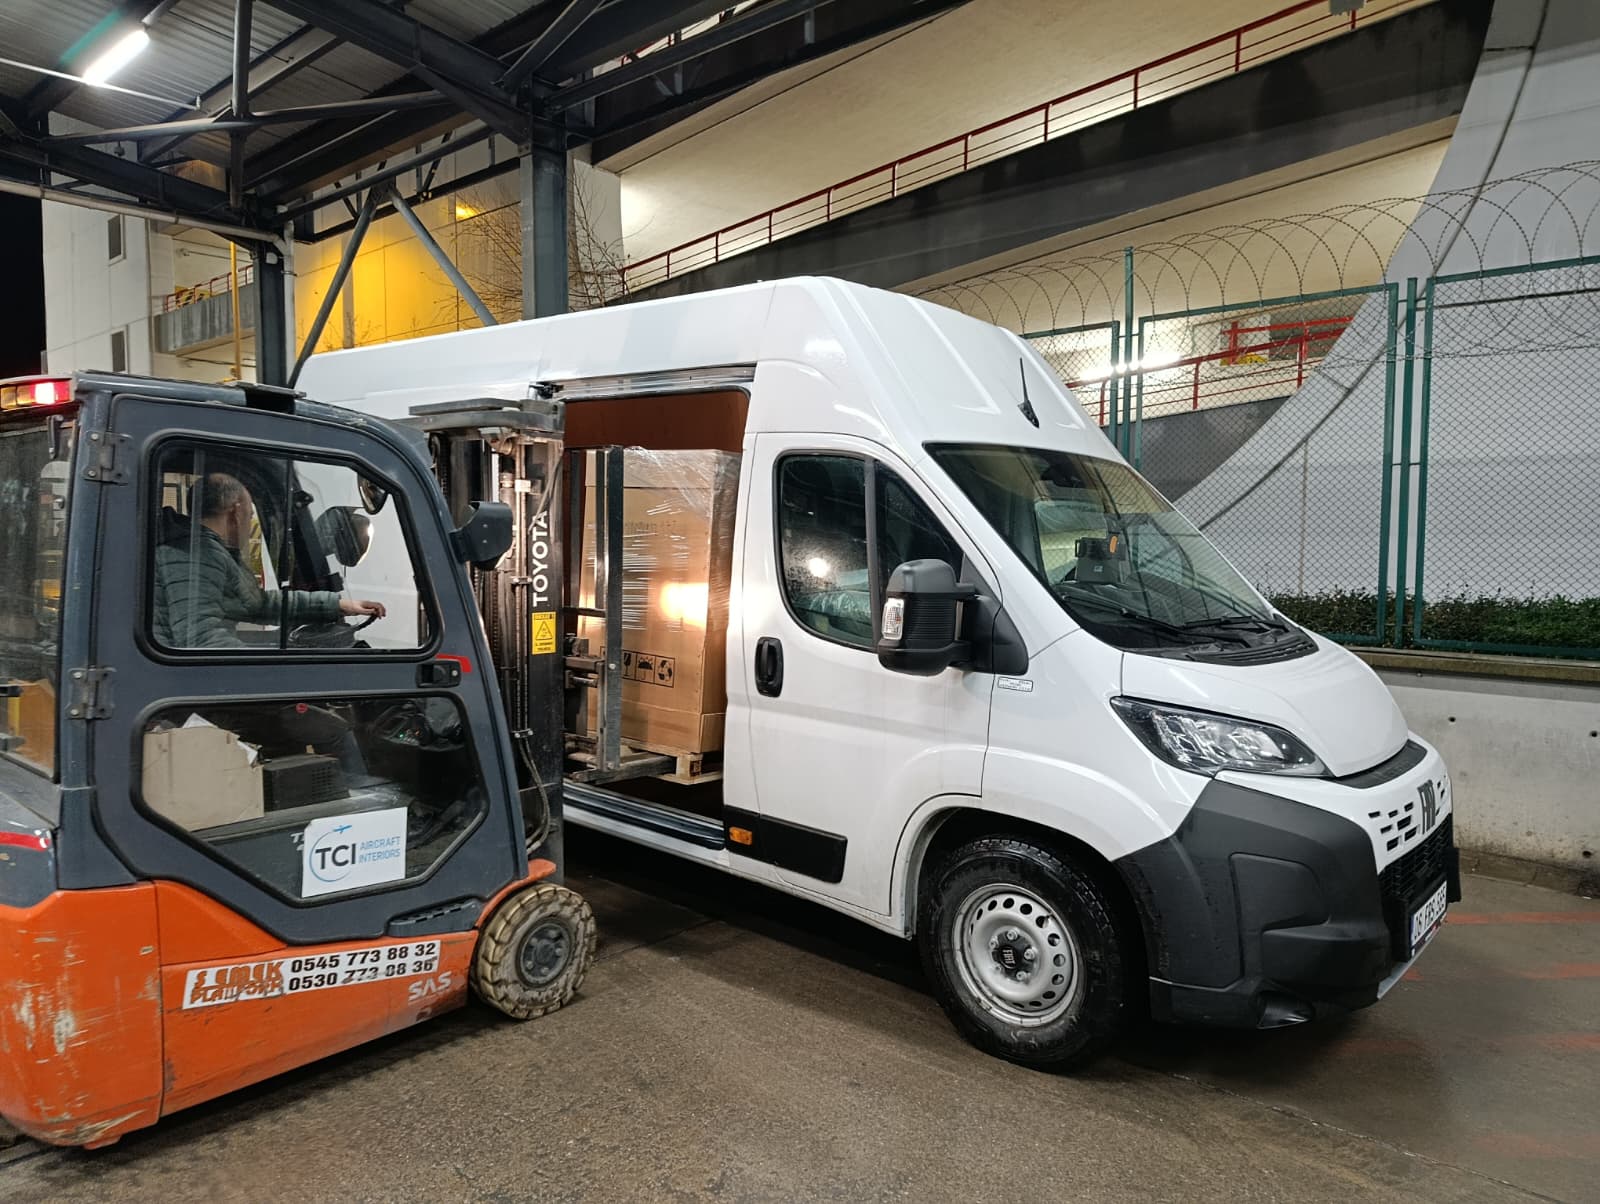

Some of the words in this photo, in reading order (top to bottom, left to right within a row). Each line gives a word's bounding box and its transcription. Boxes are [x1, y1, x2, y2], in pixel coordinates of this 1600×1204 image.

[532, 510, 549, 607] TOYOTA
[315, 843, 357, 870] TCI
[358, 848, 401, 864] INTERIORS
[359, 836, 401, 850] AIRCRAFT
[291, 954, 341, 973] 0545
[346, 949, 381, 966] 773
[387, 946, 409, 960] 88
[414, 942, 436, 957] 32
[288, 972, 338, 990] 0530
[412, 959, 434, 973] 36
[407, 970, 453, 1002] SAS
